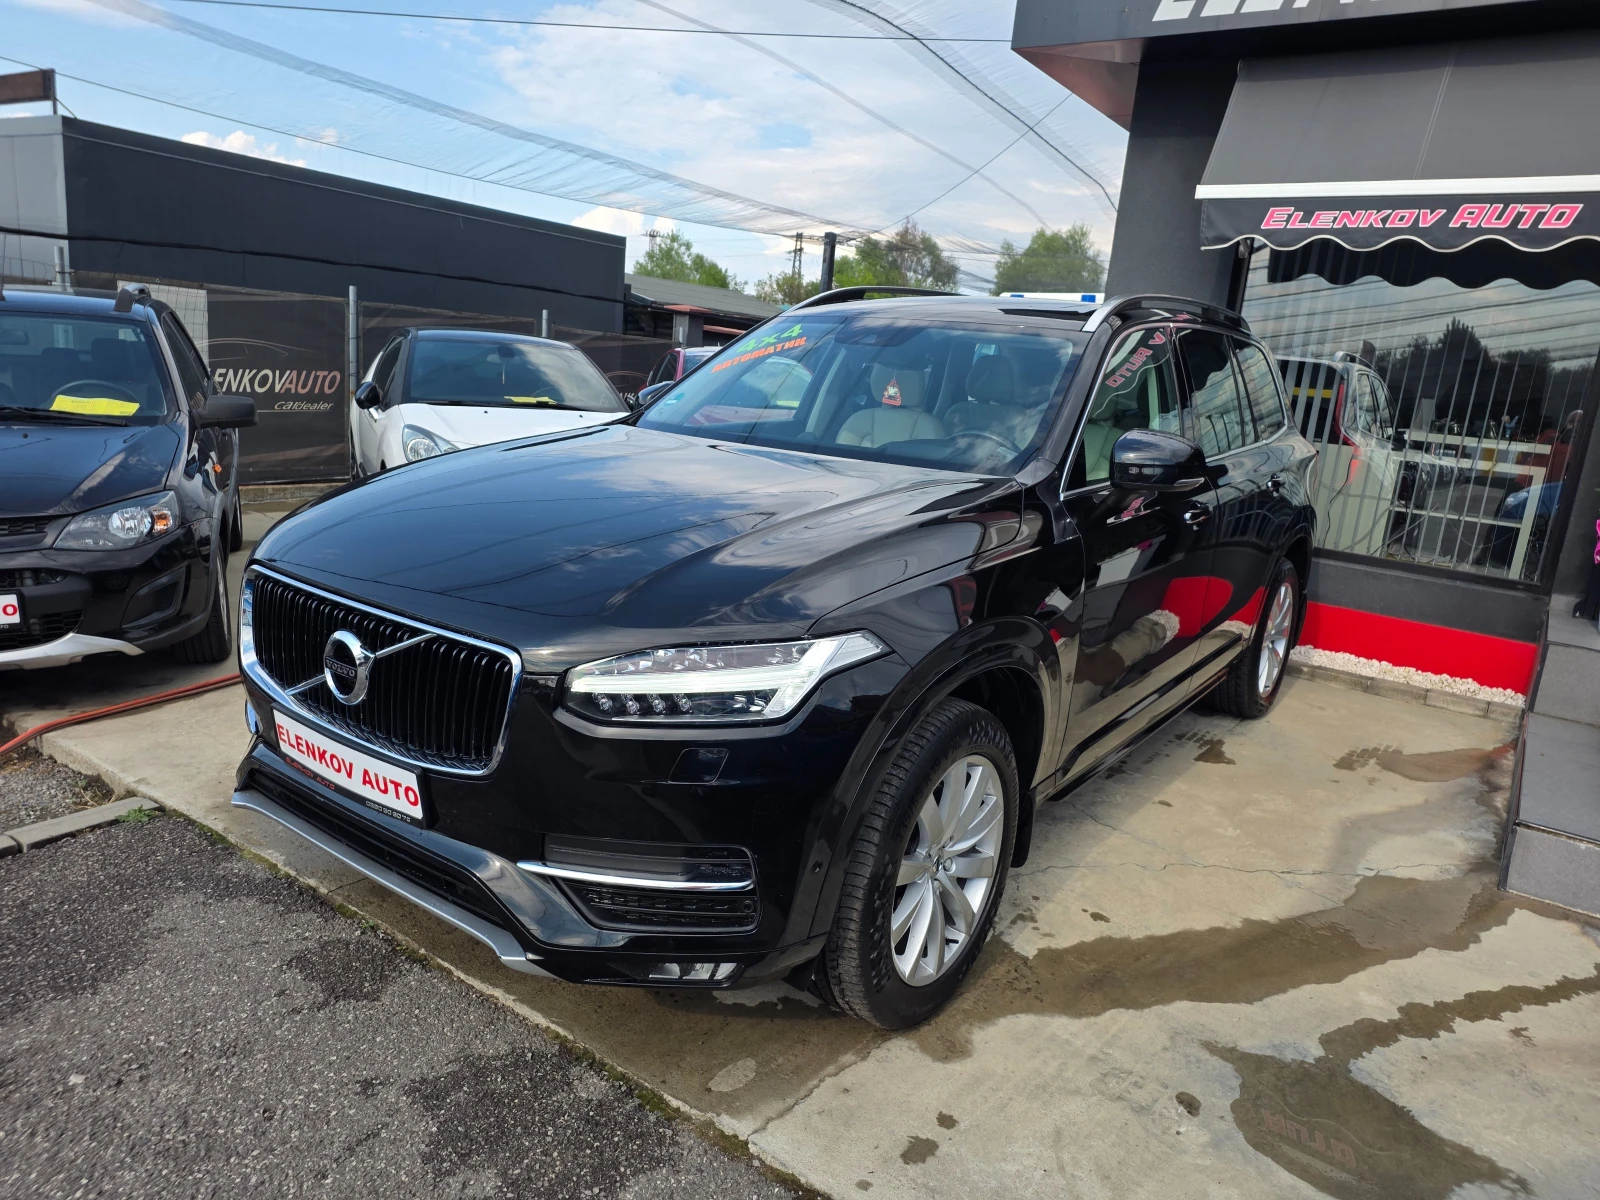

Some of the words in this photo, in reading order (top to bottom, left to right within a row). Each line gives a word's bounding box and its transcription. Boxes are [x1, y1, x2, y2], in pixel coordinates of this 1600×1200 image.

[1449, 203, 1584, 229] AUTO
[711, 336, 807, 373] АВТОМАТИК
[325, 659, 356, 677] VOLVO
[276, 722, 354, 780] ELENKOV
[361, 767, 420, 807] AUTO
[316, 776, 336, 791] AUTO
